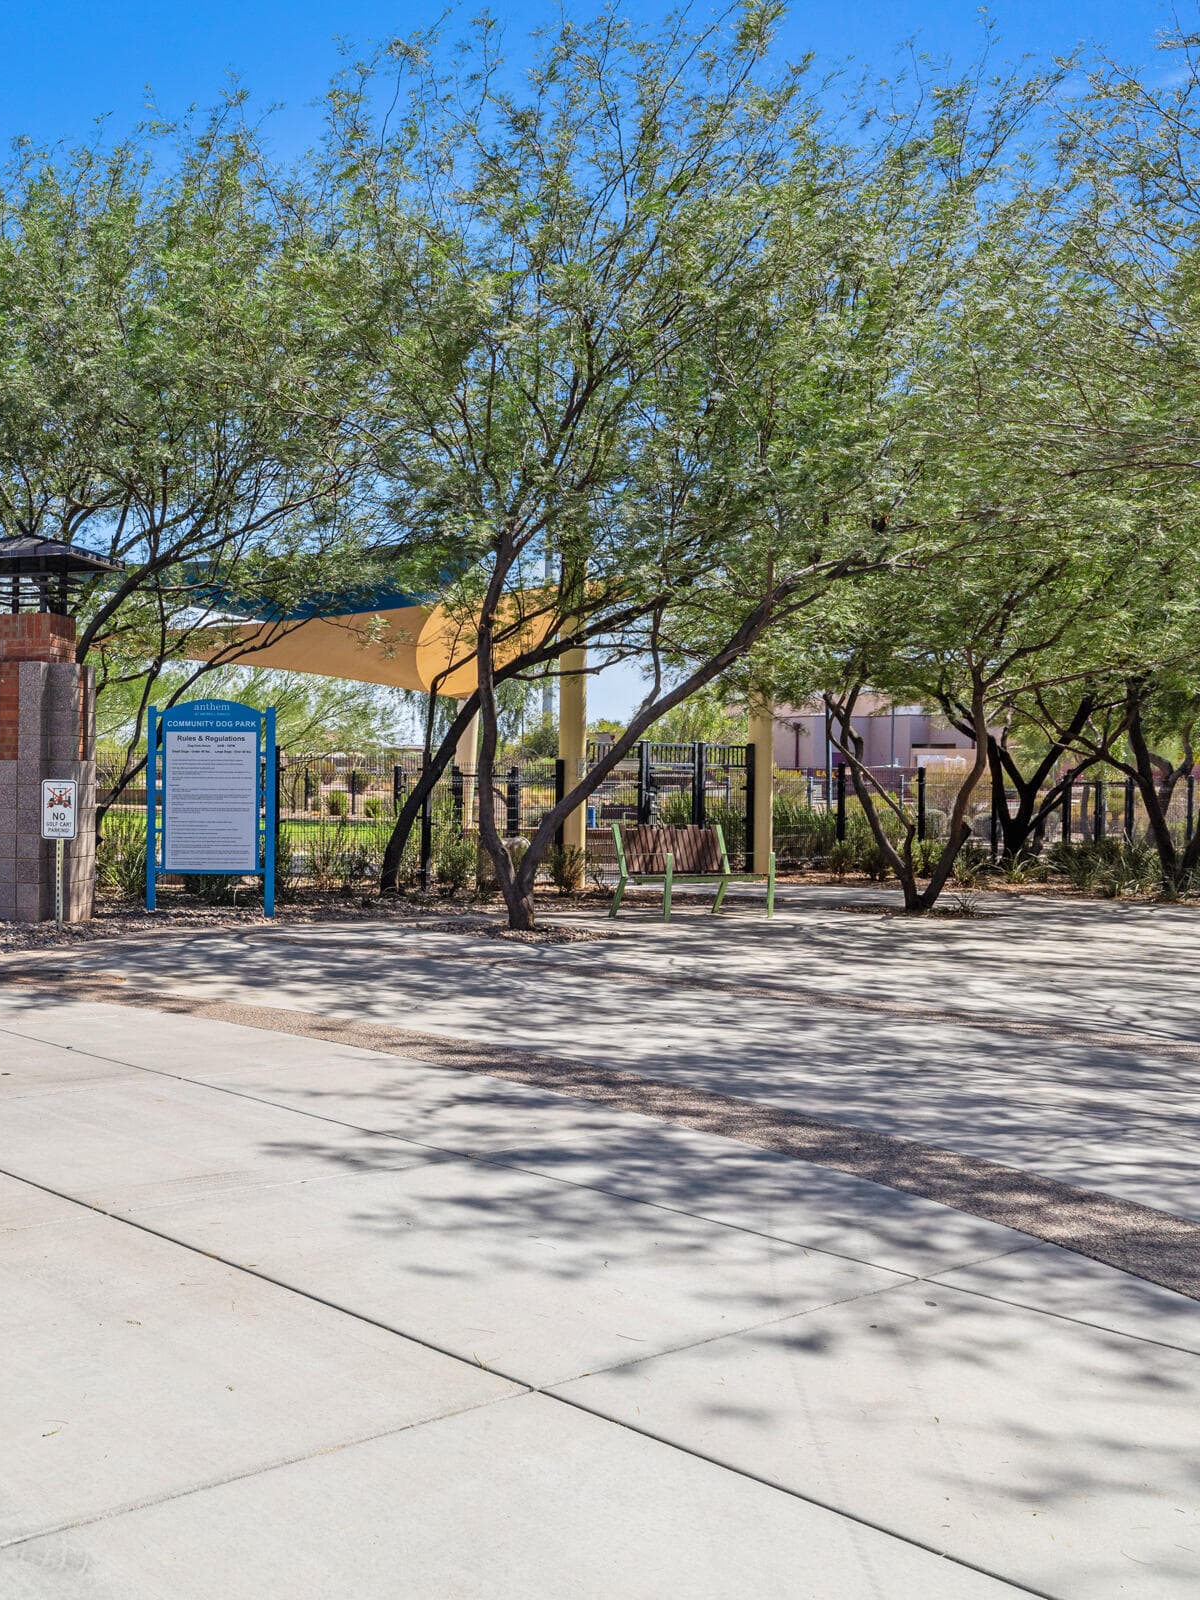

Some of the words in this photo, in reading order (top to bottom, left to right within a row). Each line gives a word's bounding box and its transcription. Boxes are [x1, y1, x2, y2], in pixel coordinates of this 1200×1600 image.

[193, 702, 230, 711] anthem
[167, 720, 213, 728] COMMUNITY
[215, 720, 233, 728] DOG
[235, 720, 257, 728] PARK
[205, 735, 246, 743] Regulations
[52, 812, 66, 821] NO
